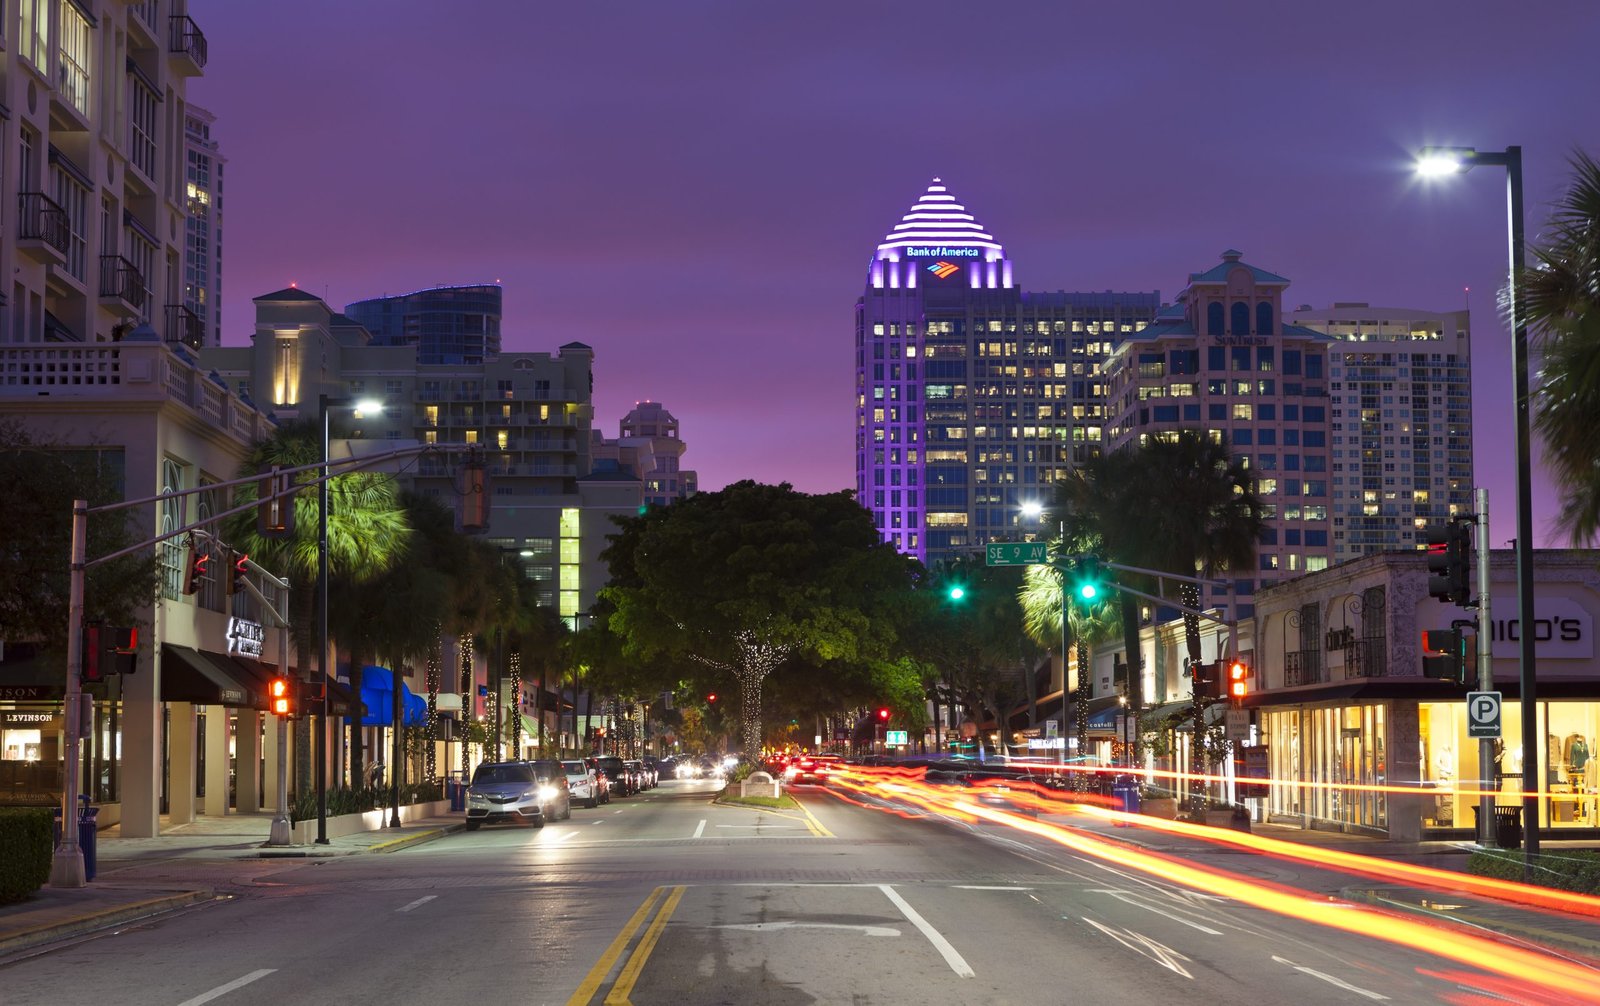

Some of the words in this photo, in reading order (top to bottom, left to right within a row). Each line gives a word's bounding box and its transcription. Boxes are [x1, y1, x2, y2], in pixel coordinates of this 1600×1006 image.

[906, 246, 930, 257] Bank
[930, 247, 940, 257] of
[941, 247, 979, 257] America
[990, 547, 1003, 559] SE
[1013, 546, 1021, 558] 9
[1031, 546, 1044, 558] AV
[1477, 700, 1494, 720] P
[6, 714, 53, 722] LEVINSON
